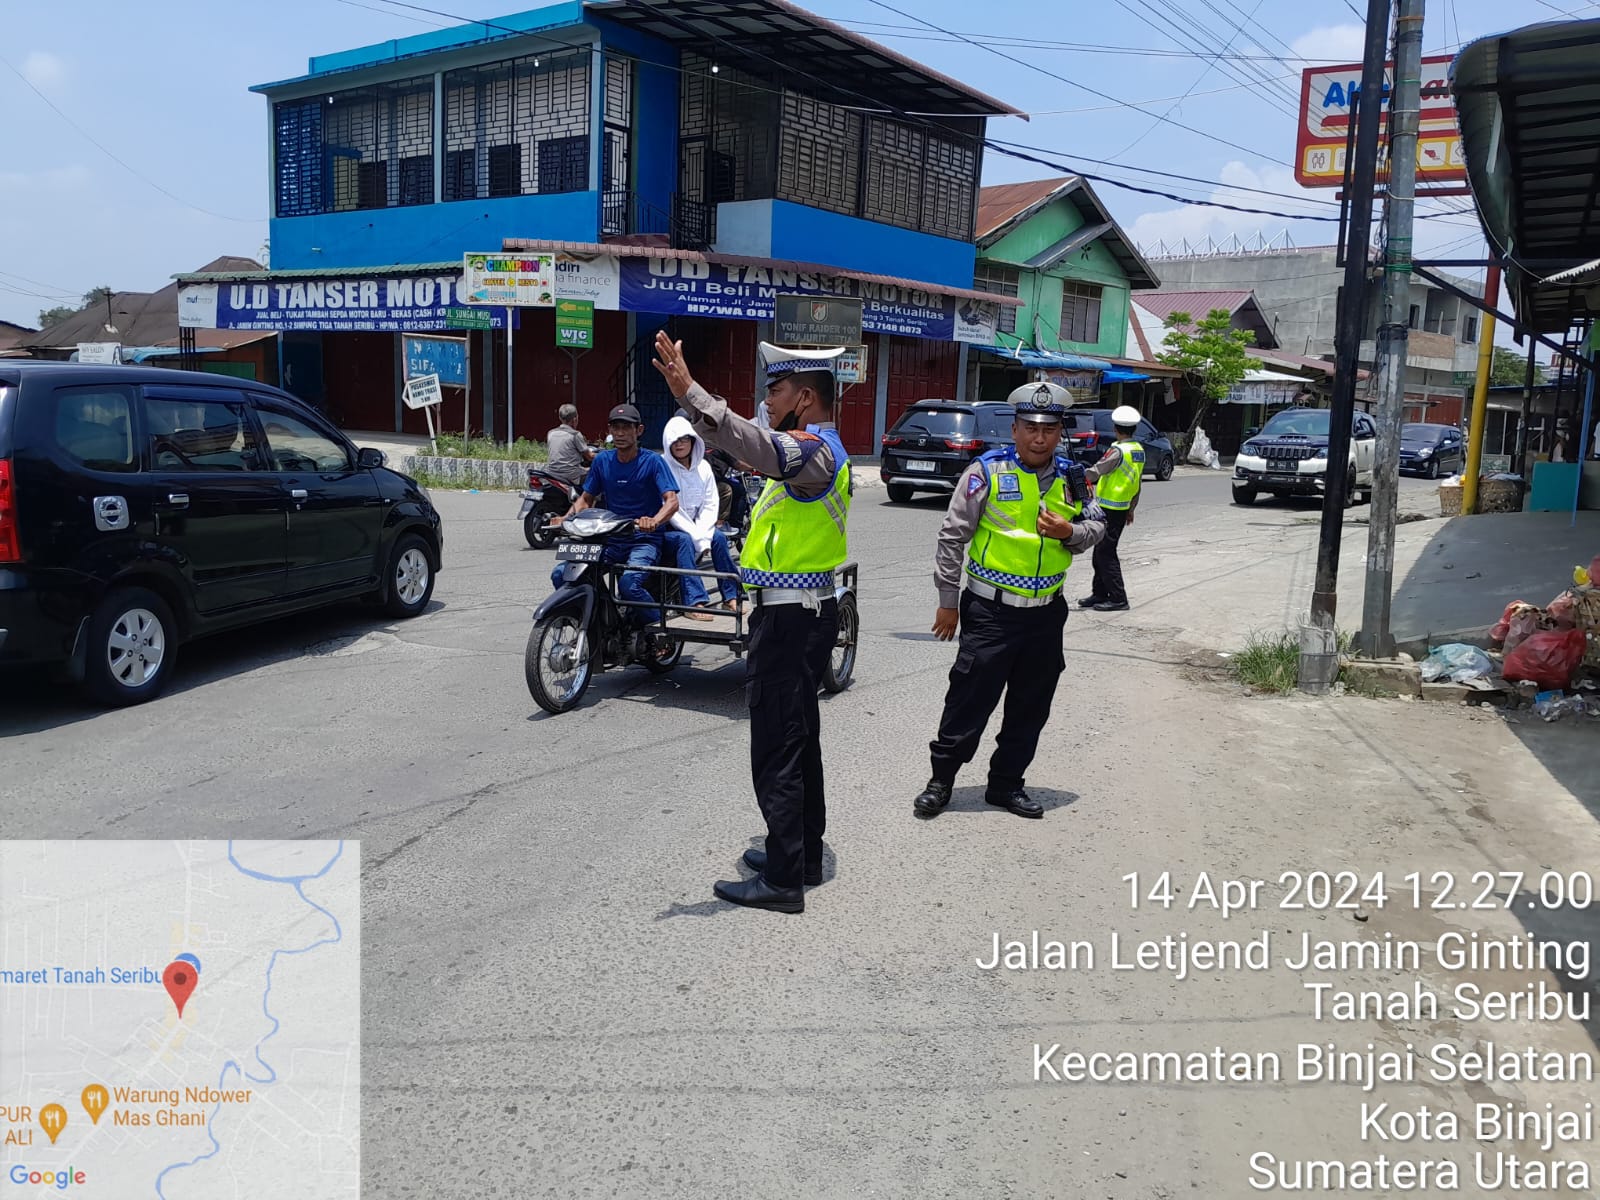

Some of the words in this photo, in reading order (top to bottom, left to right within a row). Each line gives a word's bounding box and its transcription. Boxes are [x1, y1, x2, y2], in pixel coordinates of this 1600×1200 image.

[485, 260, 540, 272] CHAMPION
[555, 261, 580, 273] diri
[568, 273, 611, 286] finance
[648, 257, 710, 280] UD
[720, 263, 851, 295] TANSER
[858, 281, 943, 309] MOTOR
[230, 284, 269, 310] U.D
[275, 281, 378, 309] TANSER
[386, 276, 467, 308] MOTO
[643, 278, 696, 293] Jual
[705, 282, 750, 297] Beli
[678, 294, 721, 304] Alamat
[748, 300, 775, 308] Jami
[256, 311, 269, 319] JUAL
[270, 311, 282, 319] BELI
[305, 310, 329, 319] TAMBAH
[348, 310, 370, 319] MOTOR
[370, 310, 387, 318] BARU
[391, 309, 412, 318] BEKAS
[412, 308, 432, 319] (CASH
[456, 309, 476, 320] SUNGAI
[687, 304, 743, 316] HP/WA
[746, 308, 775, 318] 081
[870, 301, 945, 320] Berkualitas
[318, 321, 333, 329] TIGA
[333, 321, 353, 329] TANAH
[353, 321, 375, 329] SERIBU
[403, 320, 446, 329] 0812-6367-231
[780, 322, 807, 331] YONIF
[809, 323, 841, 333] RAIDER
[843, 326, 857, 334] 100
[862, 320, 874, 329] 53
[876, 321, 898, 332] 7148
[899, 323, 922, 334] 0073
[784, 332, 826, 342] PRAJURIT
[829, 334, 853, 344] SETIA
[558, 544, 569, 553] BK
[589, 545, 601, 554] RP
